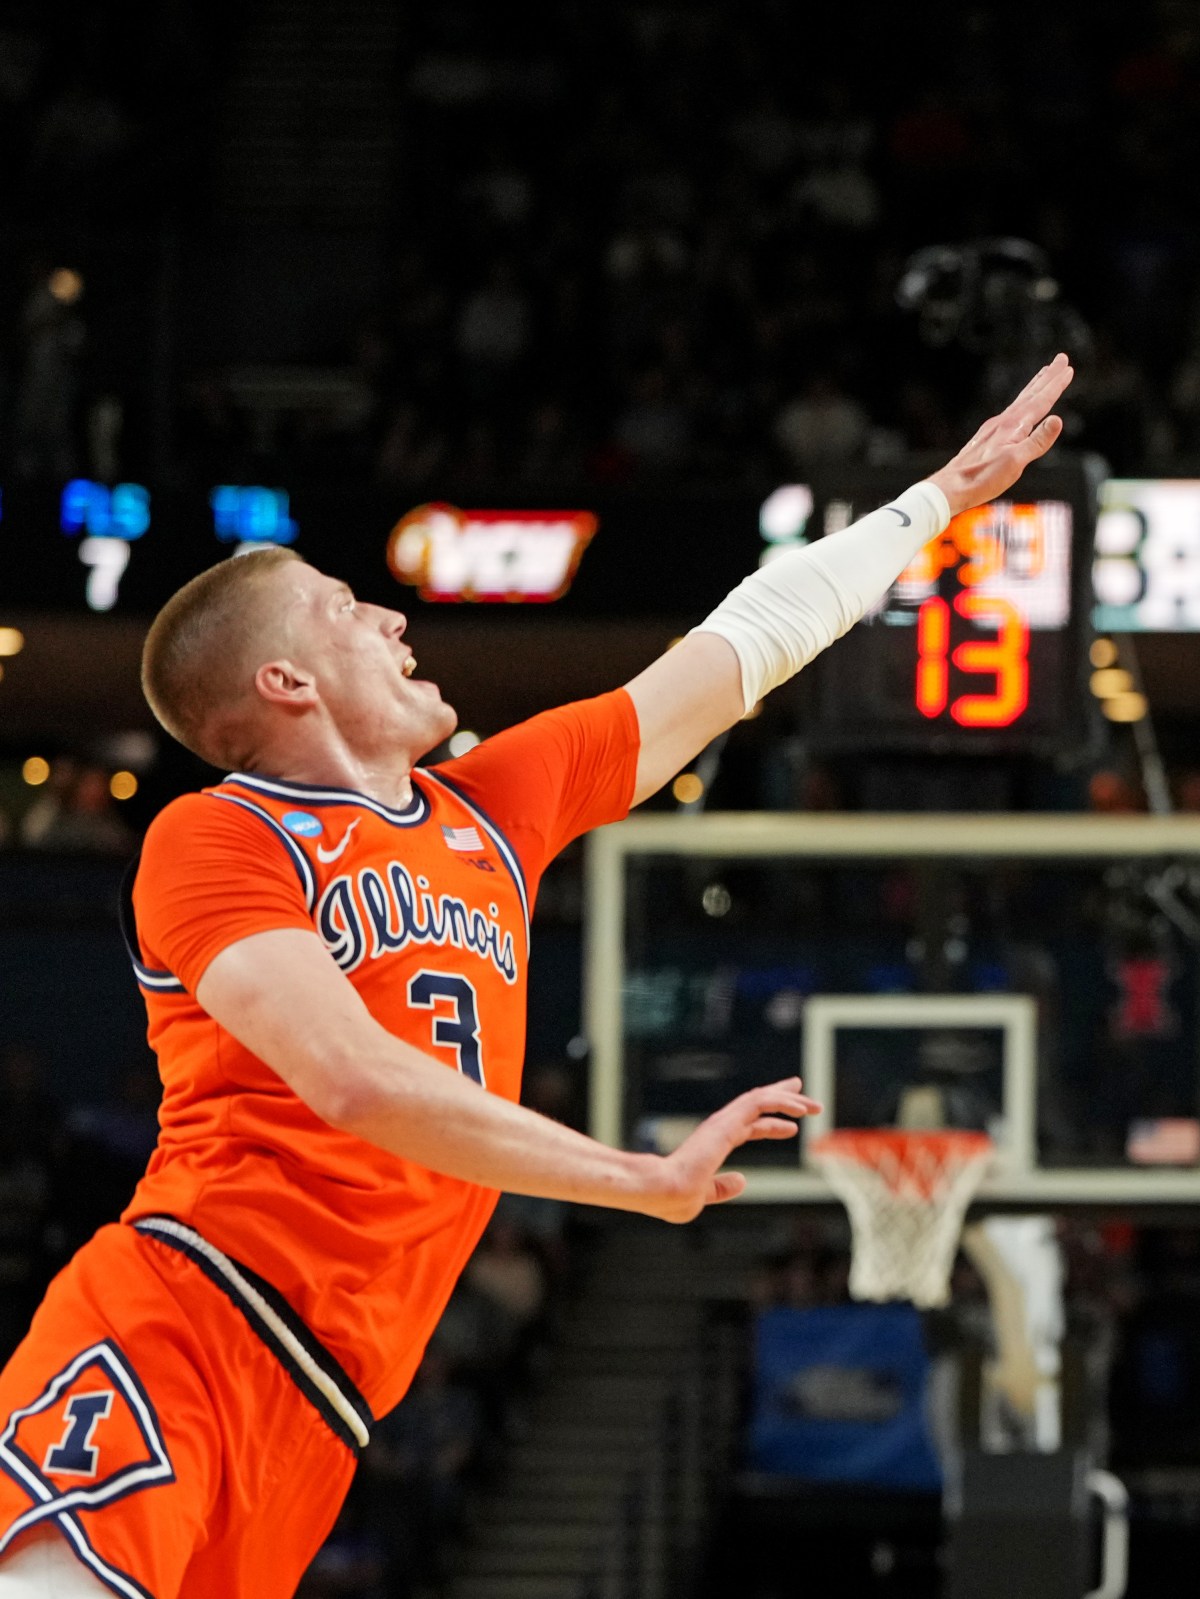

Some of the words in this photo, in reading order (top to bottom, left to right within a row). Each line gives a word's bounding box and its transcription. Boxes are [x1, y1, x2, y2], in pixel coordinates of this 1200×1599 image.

[79, 536, 131, 611] 7
[915, 588, 1031, 728] 13
[317, 861, 517, 985] Illinois
[407, 968, 486, 1089] 3
[42, 1390, 114, 1477] I
